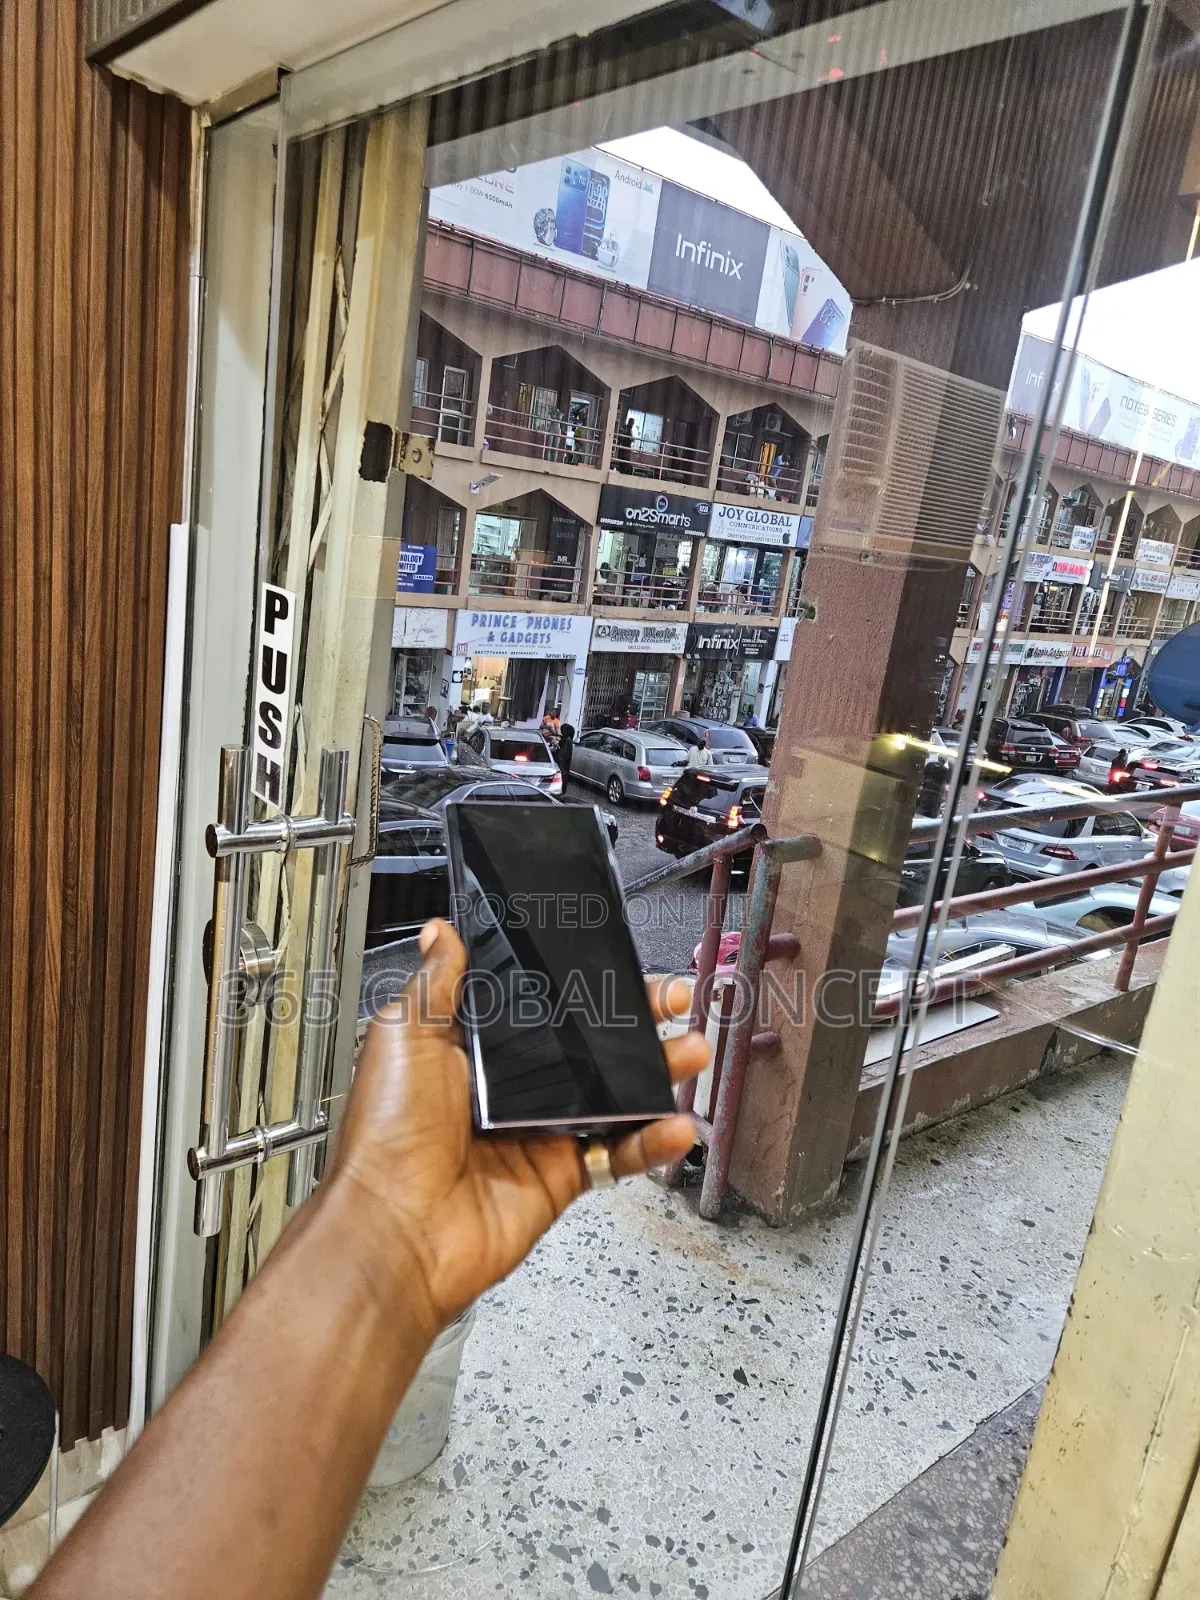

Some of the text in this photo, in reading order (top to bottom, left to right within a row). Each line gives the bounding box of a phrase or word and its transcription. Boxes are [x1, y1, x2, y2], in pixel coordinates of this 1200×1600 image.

[614, 169, 643, 190] Android
[675, 233, 744, 280] Infinix
[625, 507, 691, 527] on2Smarts
[719, 506, 793, 527] JOY GLOBAL
[729, 521, 783, 534] COMMUNICATIONS
[471, 613, 573, 631] PRINCE PHONES
[487, 631, 551, 644] & GADGETS
[698, 634, 739, 650] Infinix
[254, 589, 289, 806] PUSH
